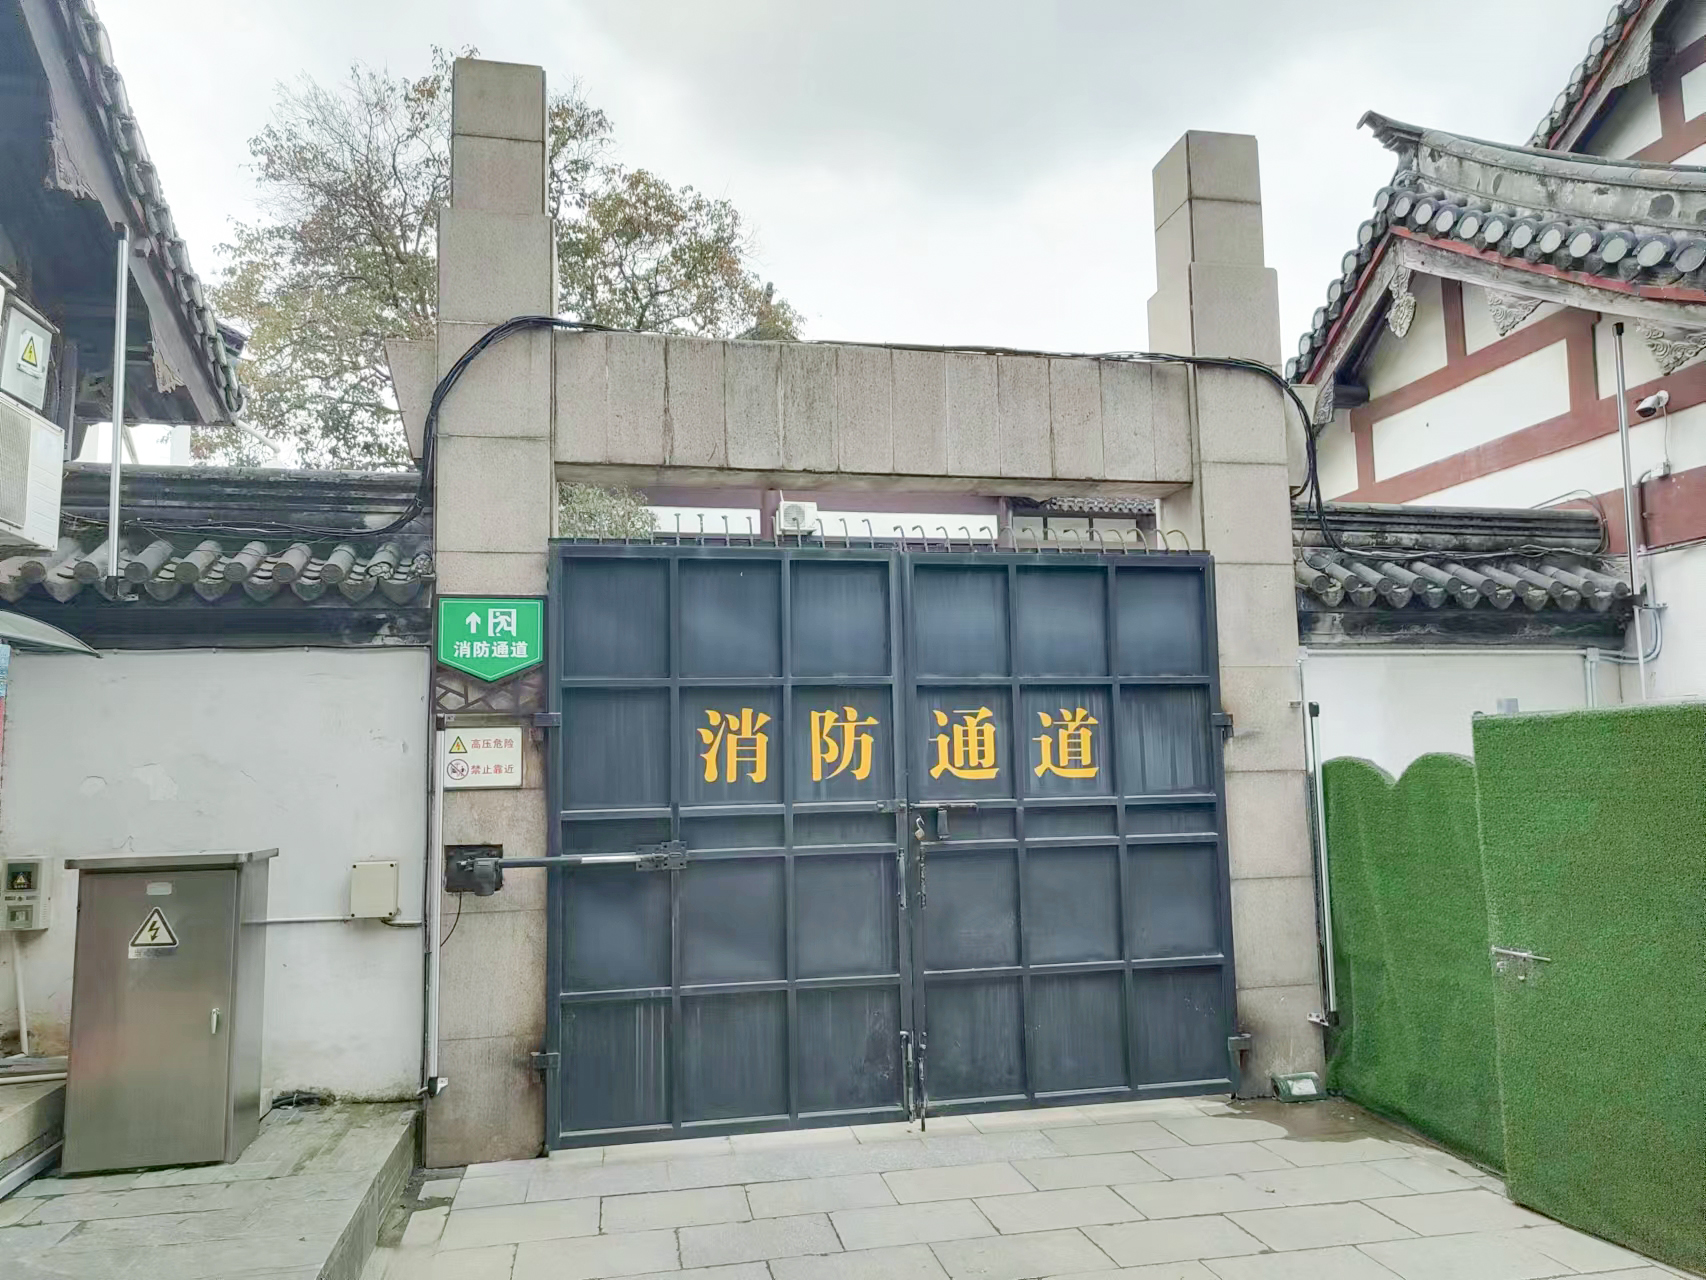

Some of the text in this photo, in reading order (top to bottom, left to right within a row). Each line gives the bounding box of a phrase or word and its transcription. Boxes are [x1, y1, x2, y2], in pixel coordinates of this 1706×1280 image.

[453, 640, 529, 659] 消防通道
[471, 738, 514, 749] 高压危险
[697, 706, 1100, 783] 消防通道
[471, 764, 515, 775] 禁止靠近
